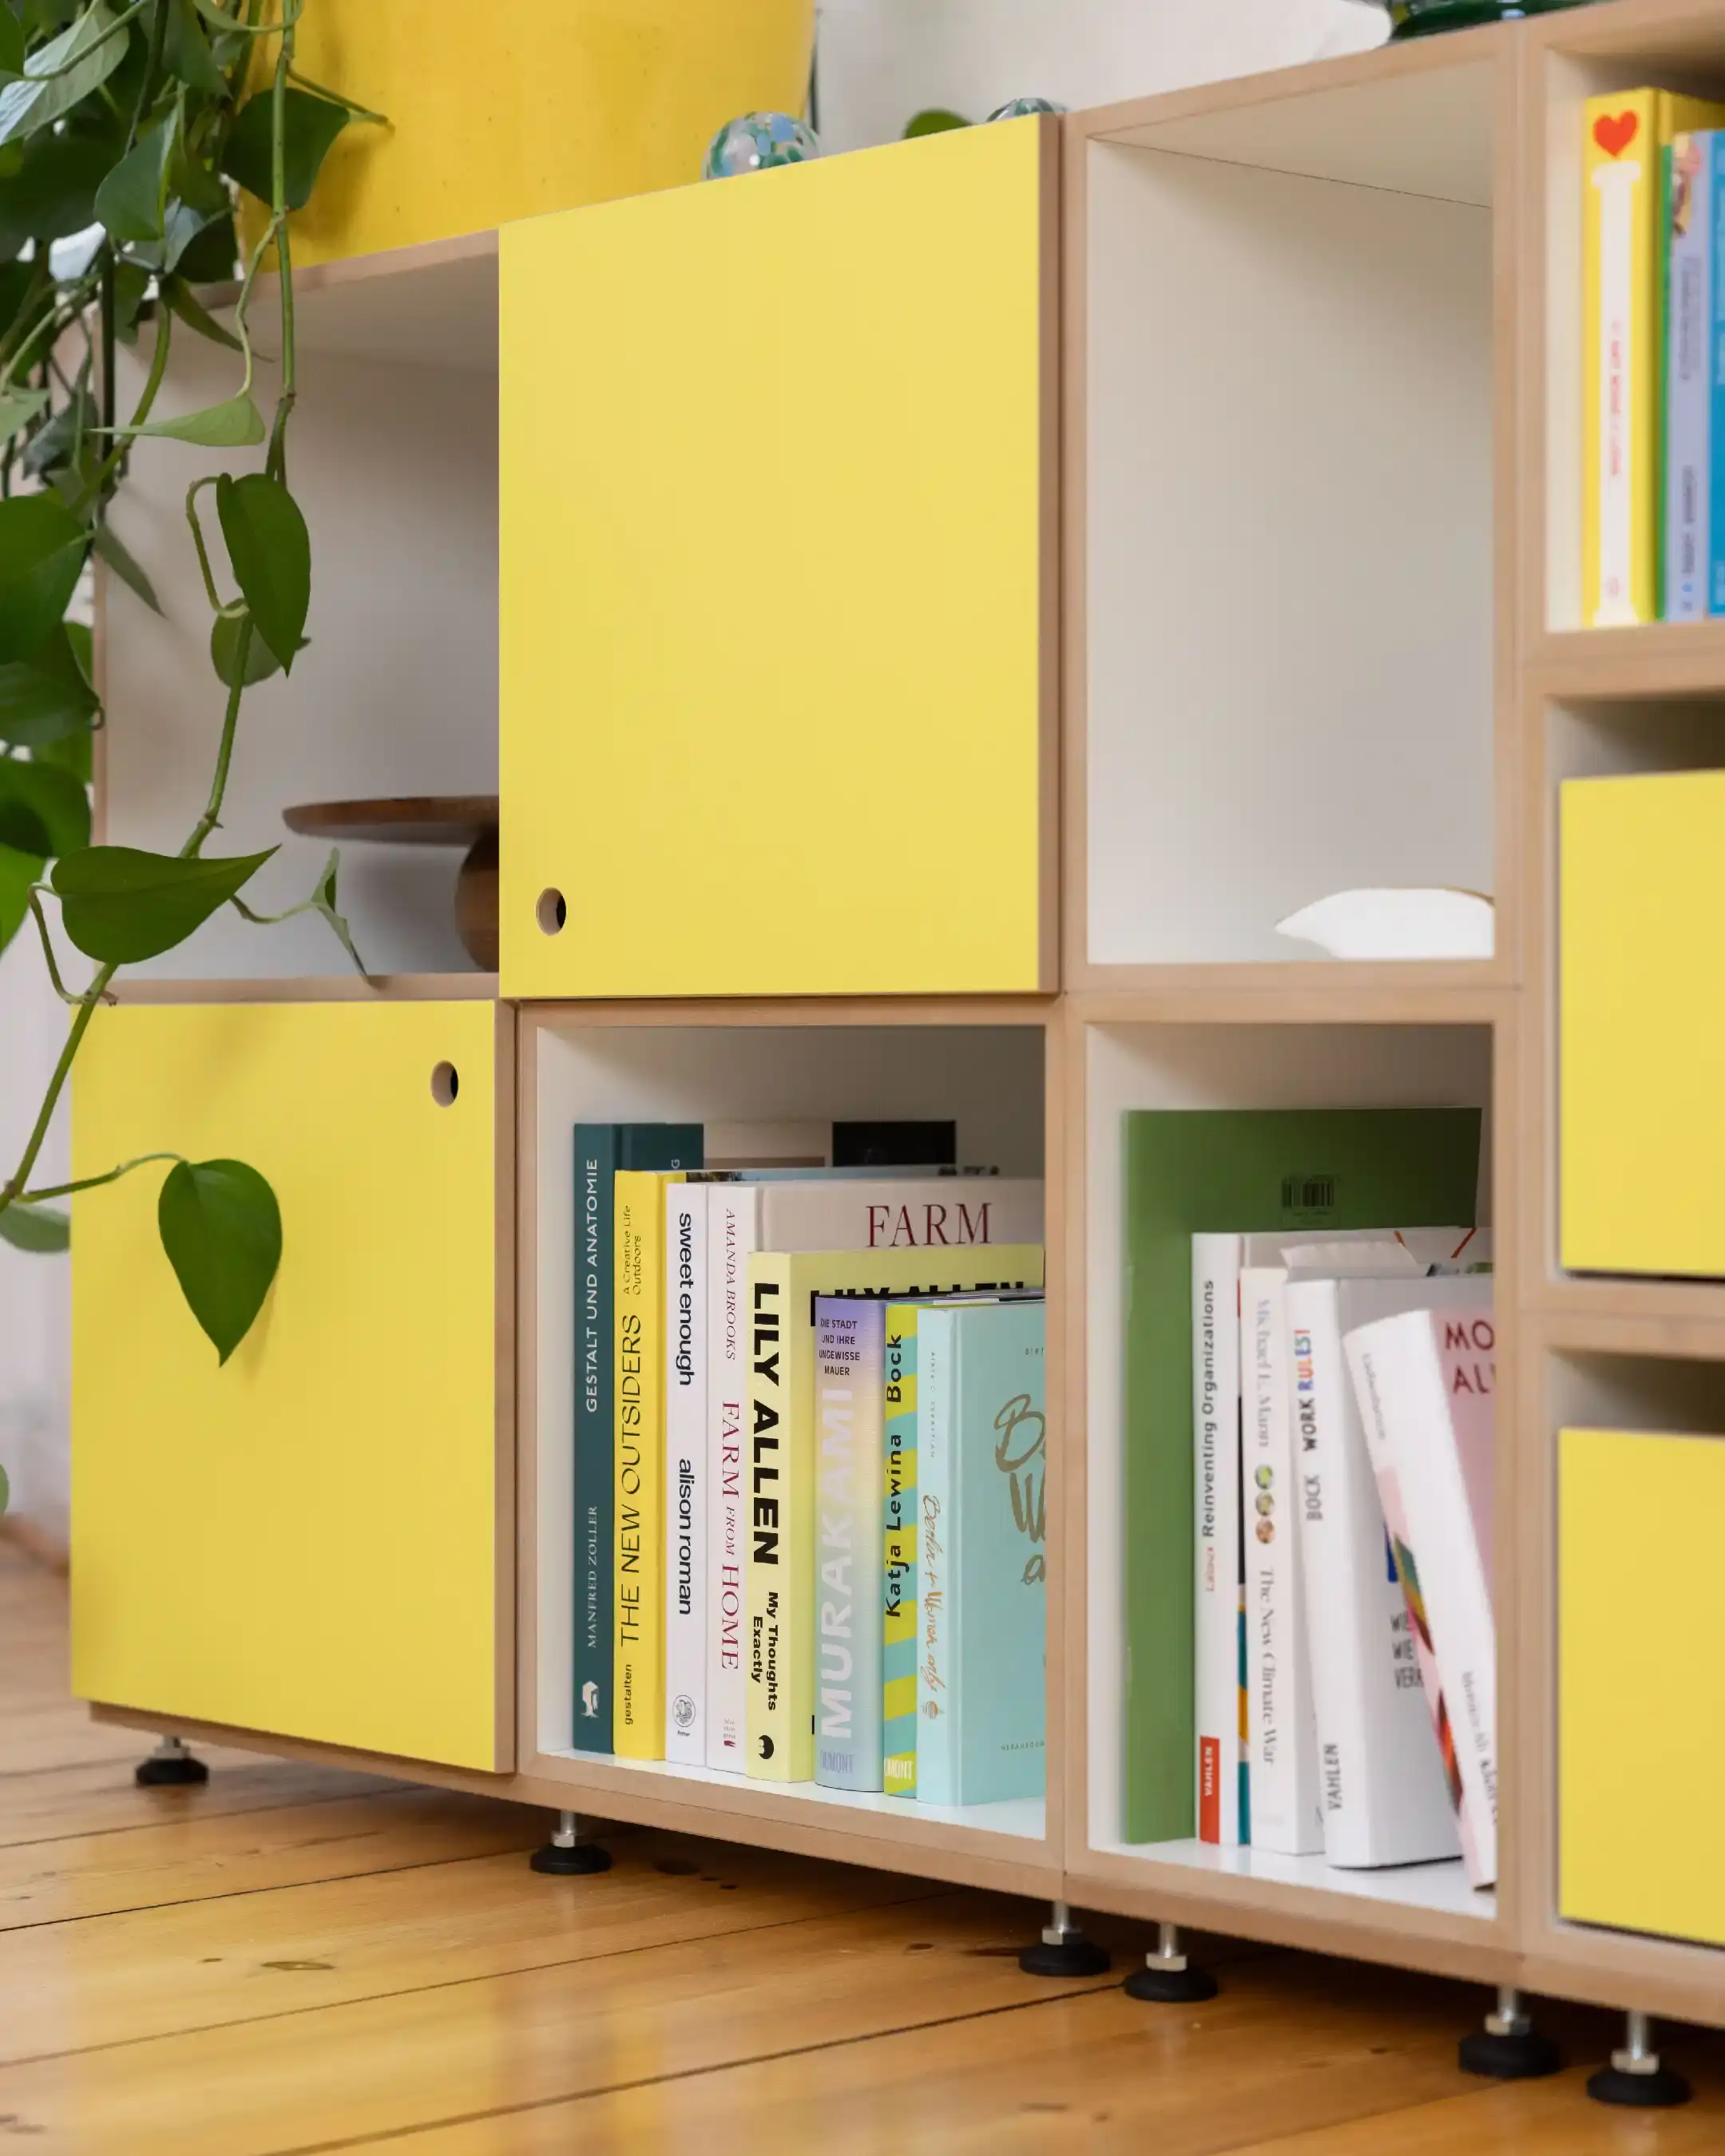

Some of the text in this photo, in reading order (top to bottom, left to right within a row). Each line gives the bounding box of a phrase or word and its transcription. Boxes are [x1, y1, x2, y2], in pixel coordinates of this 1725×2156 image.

[866, 1203, 992, 1246] FARM
[586, 1159, 597, 1412] GESTALT UND ANATOMIE
[676, 1213, 694, 1385] sweet enough
[821, 1318, 857, 1329] DIE STADT
[819, 1349, 859, 1360] UNGEWISSE
[825, 1365, 849, 1375] MAUER
[1202, 1281, 1216, 1414] Organizations
[722, 1401, 740, 1499] FARM
[754, 1283, 779, 1564] LILY ALLEN
[886, 1334, 910, 1617] Katja Lewina Bock
[1299, 1398, 1317, 1452] WORK
[621, 1315, 640, 1647] THE NEW OUTSIDERS
[1203, 1422, 1216, 1536] Reinventing
[1306, 1476, 1323, 1520] BOCK
[680, 1459, 694, 1615] alison roman
[821, 1389, 854, 1739] MURAKAMI
[722, 1564, 739, 1669] HOME
[751, 1616, 763, 1683] Exactly
[767, 1591, 779, 1710] My Thoughts
[1259, 1567, 1277, 1766] The New Climate War
[625, 1665, 633, 1725] gestalten
[1204, 1746, 1213, 1796] VAHLEN
[1324, 1743, 1342, 1810] VAHLEN
